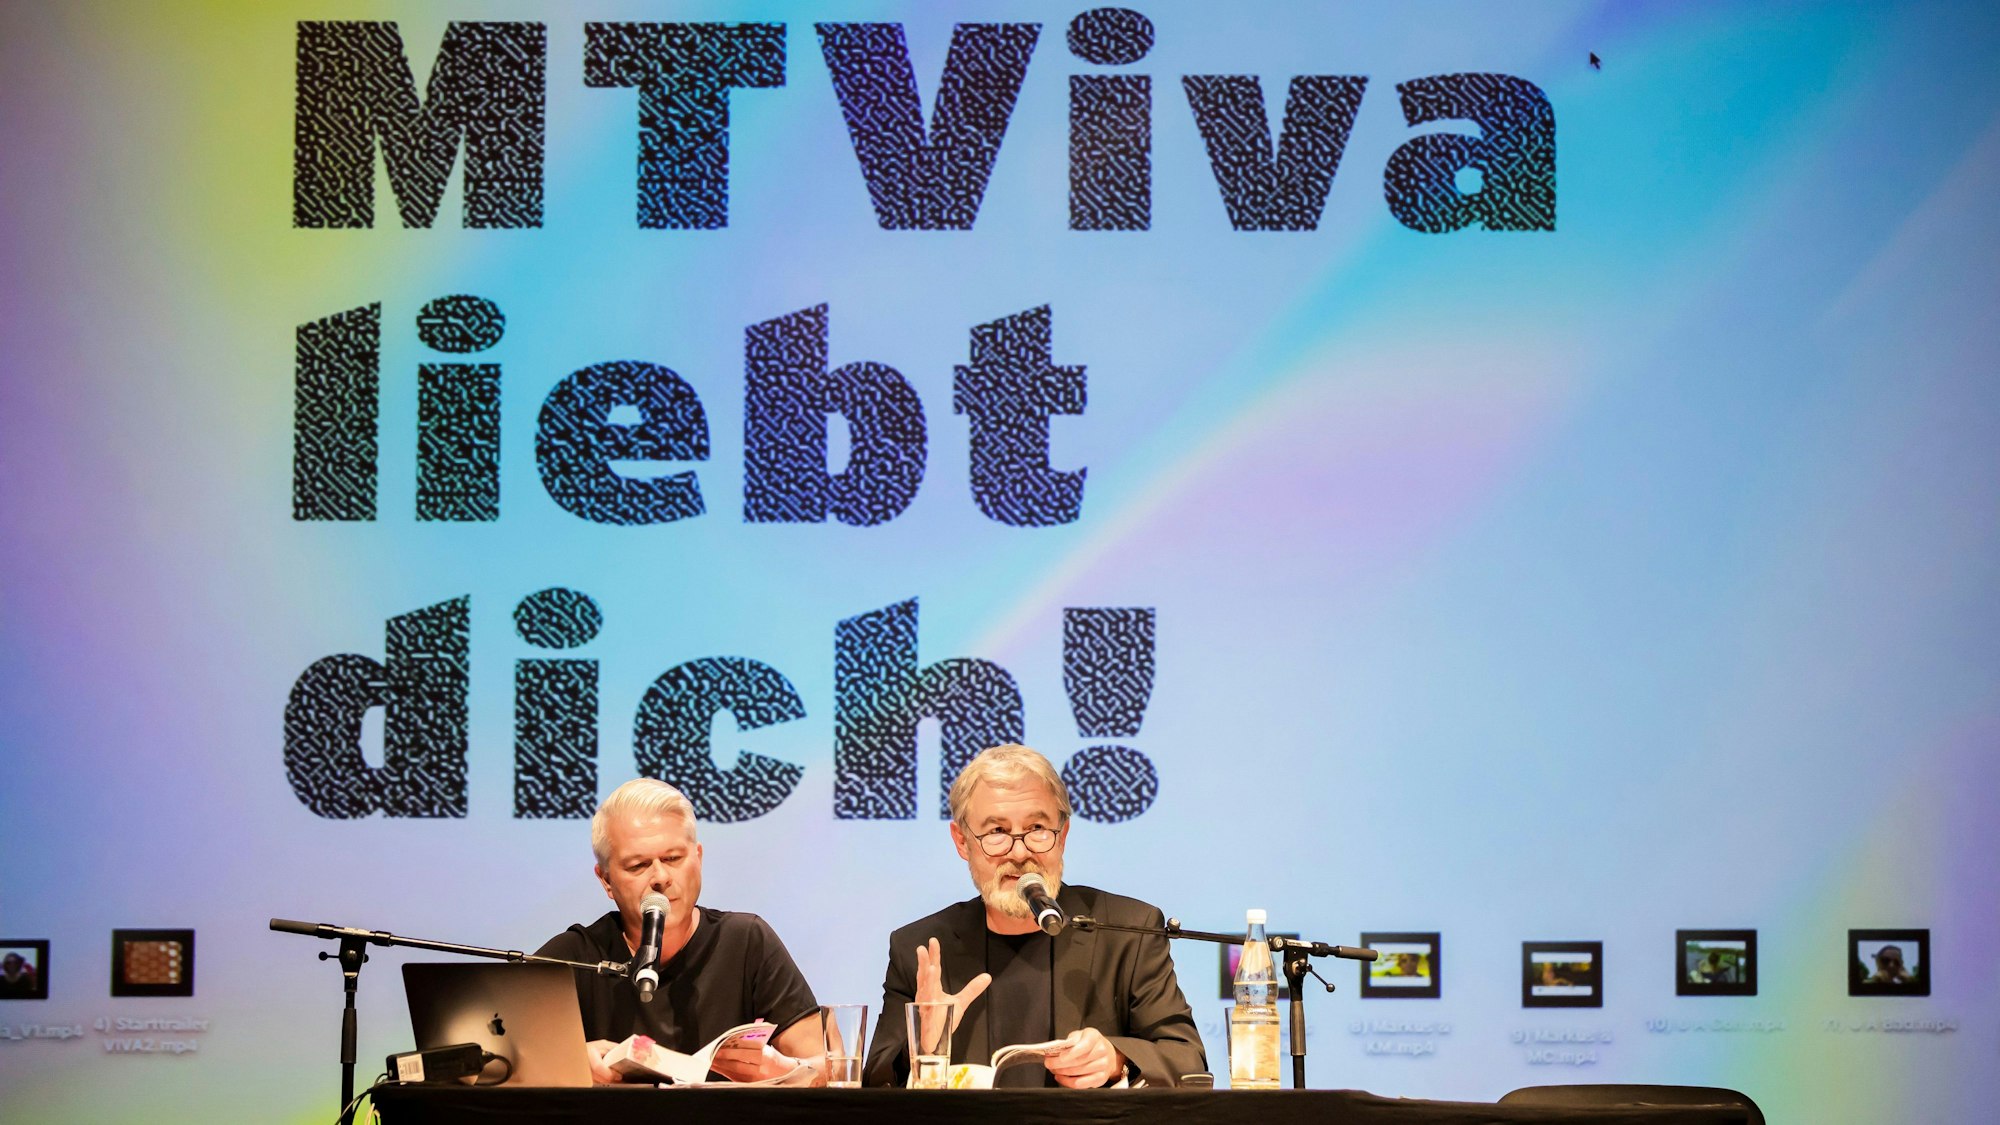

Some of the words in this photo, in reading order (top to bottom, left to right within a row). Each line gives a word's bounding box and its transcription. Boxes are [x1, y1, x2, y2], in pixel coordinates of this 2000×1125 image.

[292, 8, 1557, 233] MTViva
[292, 293, 1088, 527] liebt
[283, 586, 1160, 825] dich!
